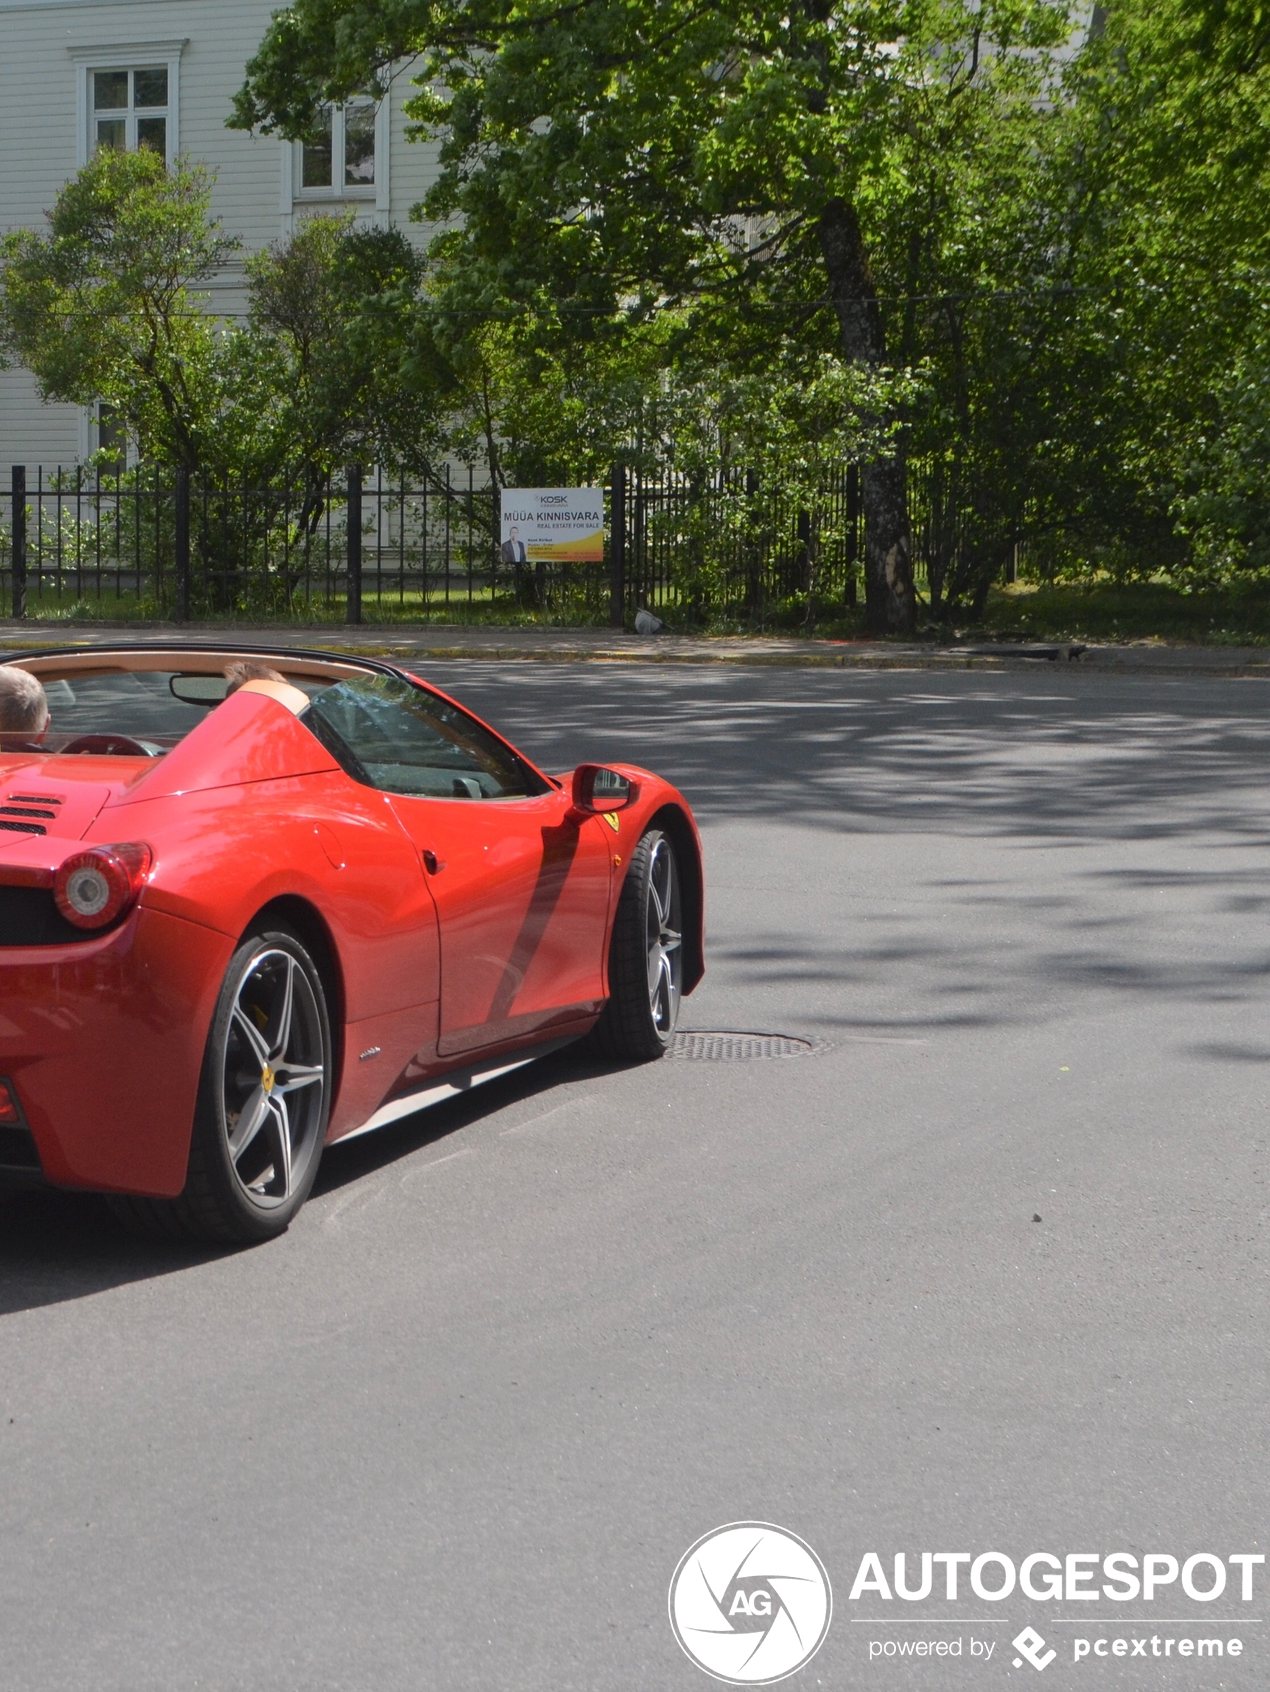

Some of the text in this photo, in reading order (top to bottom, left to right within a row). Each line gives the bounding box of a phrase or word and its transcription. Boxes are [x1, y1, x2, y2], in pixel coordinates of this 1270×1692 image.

[540, 495, 568, 503] KOSK
[504, 510, 600, 522] MÜÜA KINNISVARA
